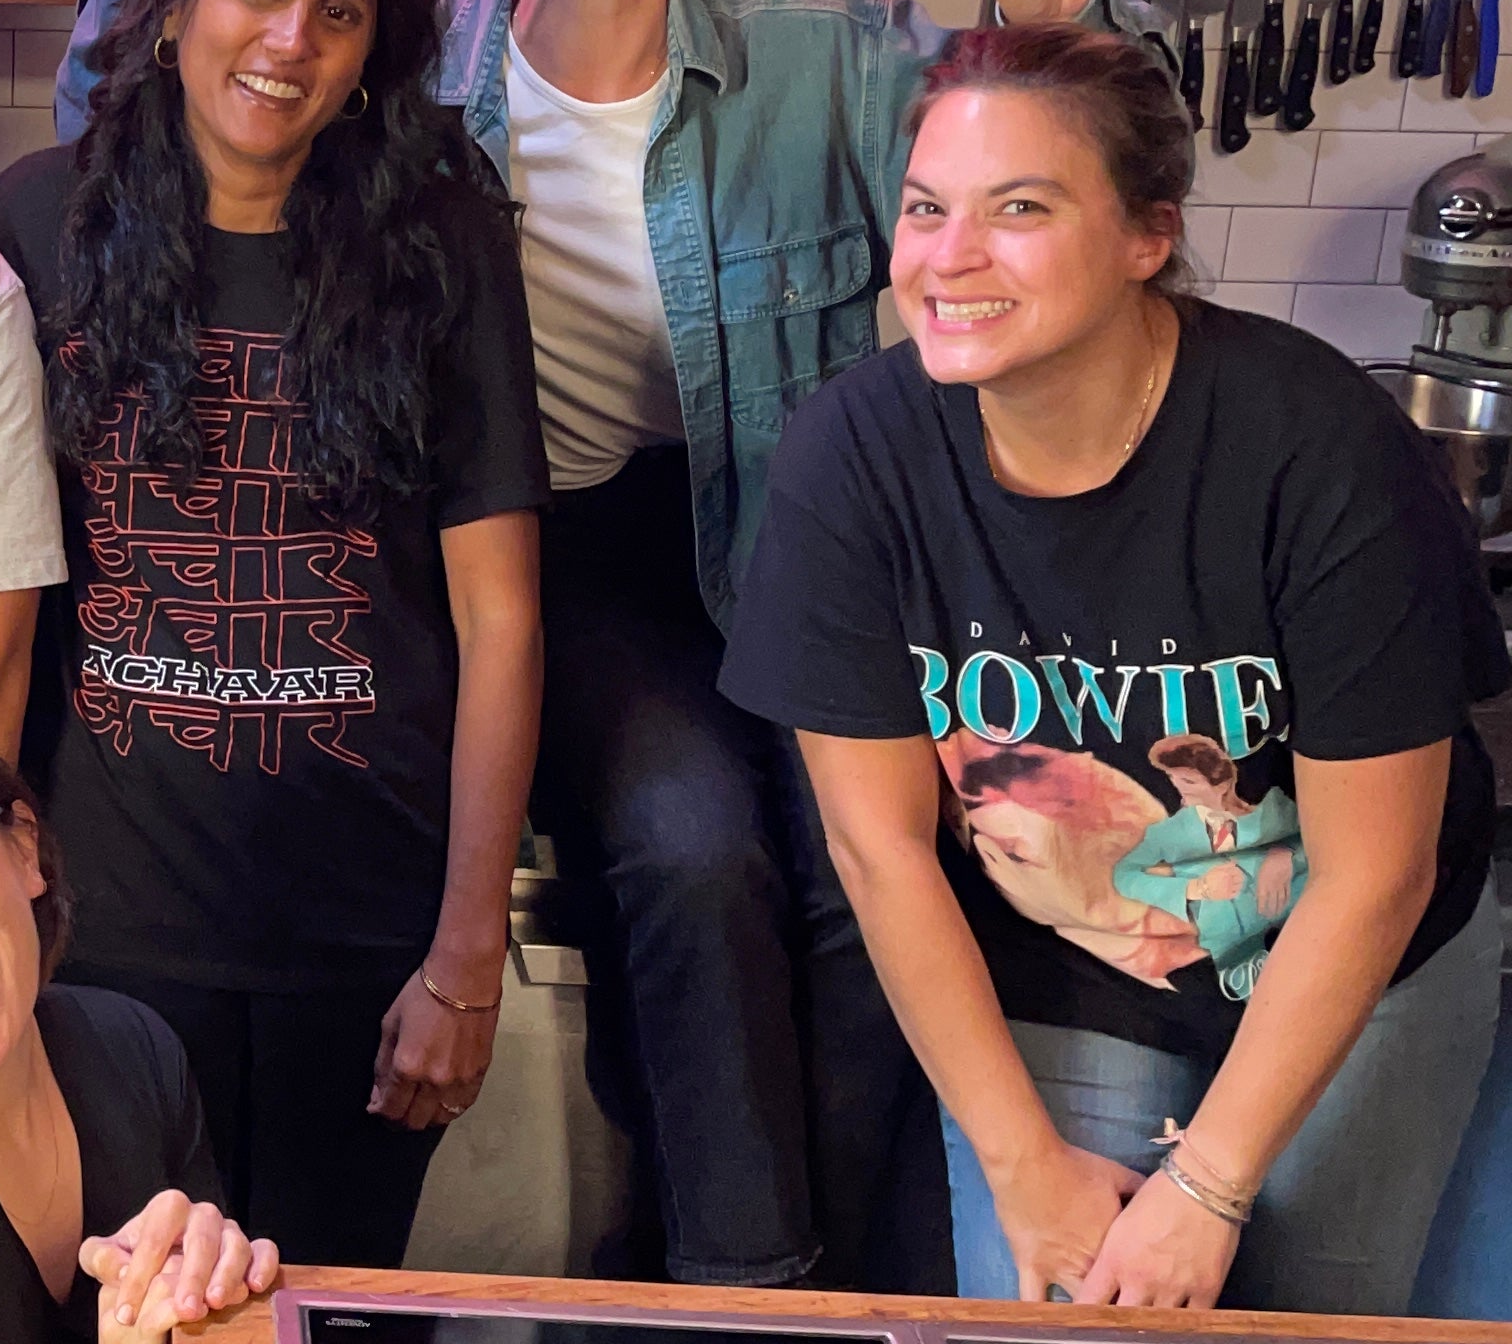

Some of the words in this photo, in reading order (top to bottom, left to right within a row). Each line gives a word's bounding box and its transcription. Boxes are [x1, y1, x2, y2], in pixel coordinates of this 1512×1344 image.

[971, 621, 1177, 656] DAVID
[84, 645, 376, 703] ACHAAR
[908, 644, 1290, 761] BOWIE
